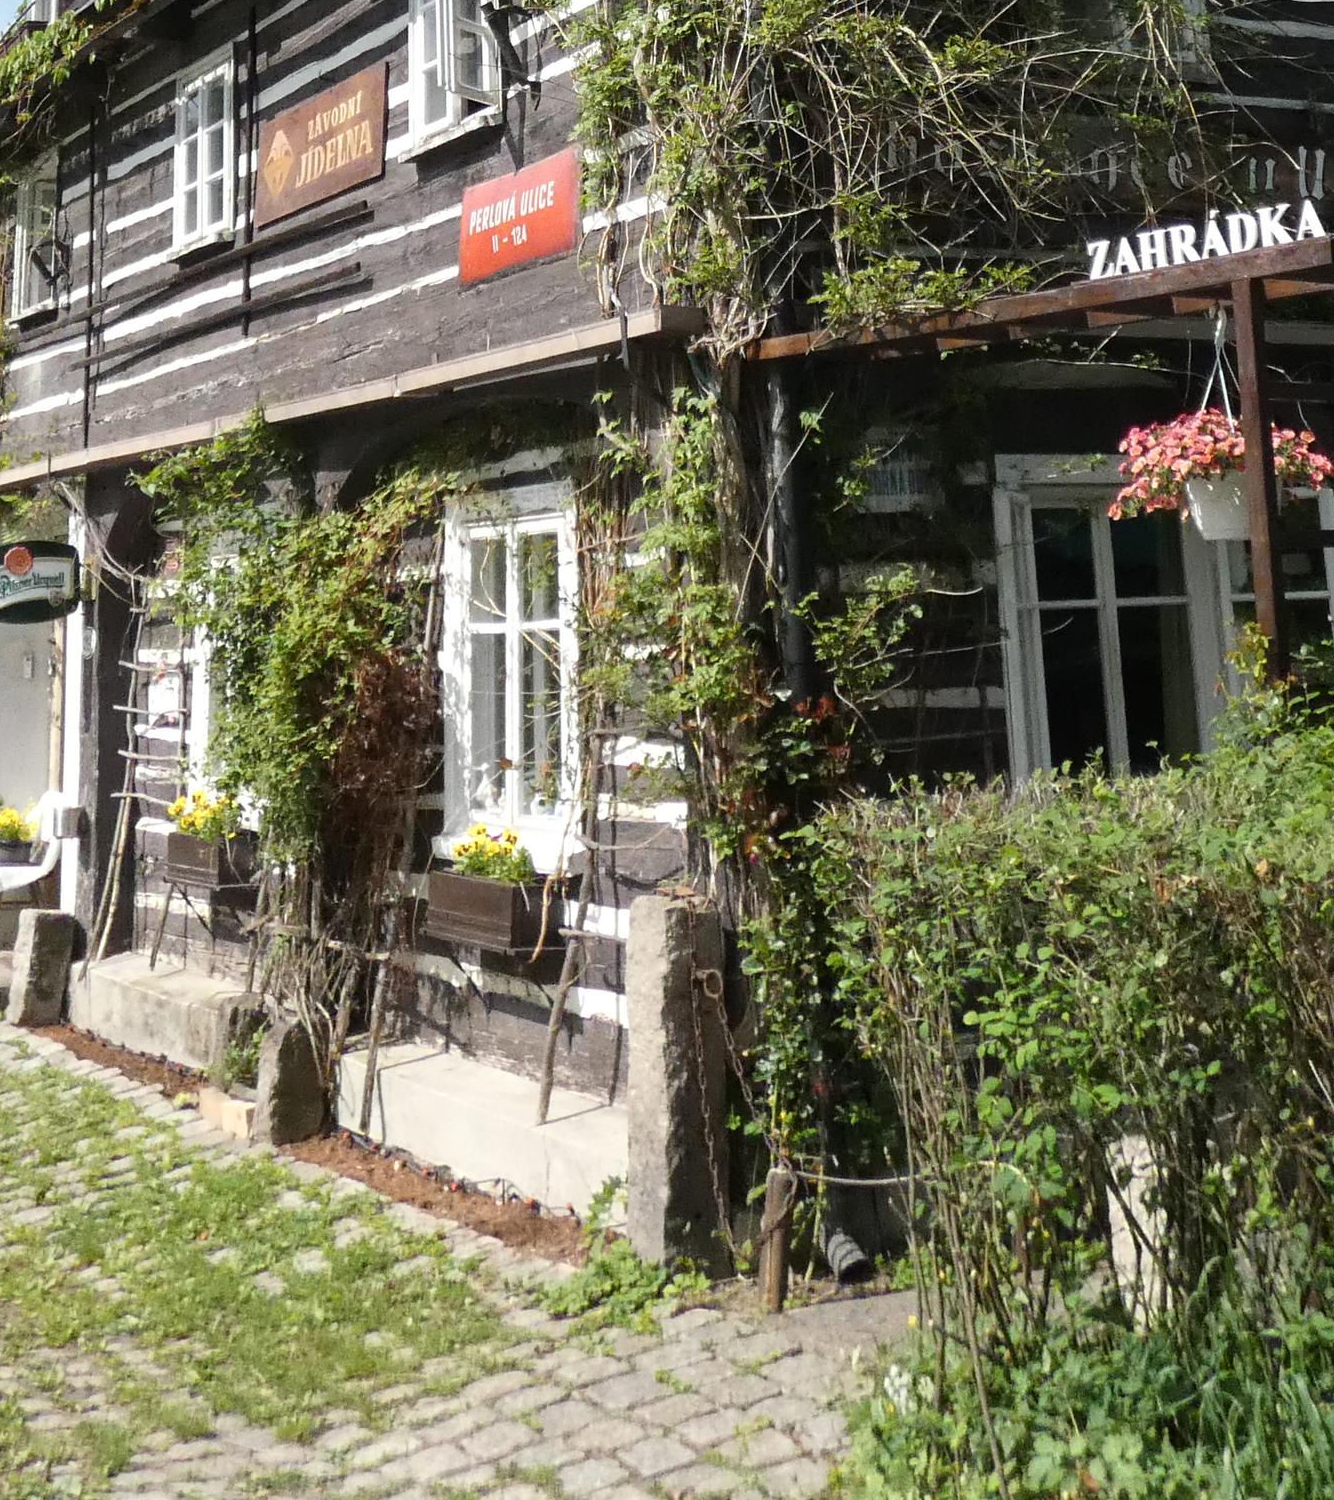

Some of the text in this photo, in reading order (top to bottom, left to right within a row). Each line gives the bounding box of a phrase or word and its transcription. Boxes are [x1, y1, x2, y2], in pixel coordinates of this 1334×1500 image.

[308, 90, 362, 141] ZÁVODNÍ
[295, 120, 374, 189] JÍDELNA
[469, 180, 555, 236] PERLOVÁ ULICE
[511, 224, 527, 246] 124
[1087, 199, 1326, 281] ZAHRÁDKA
